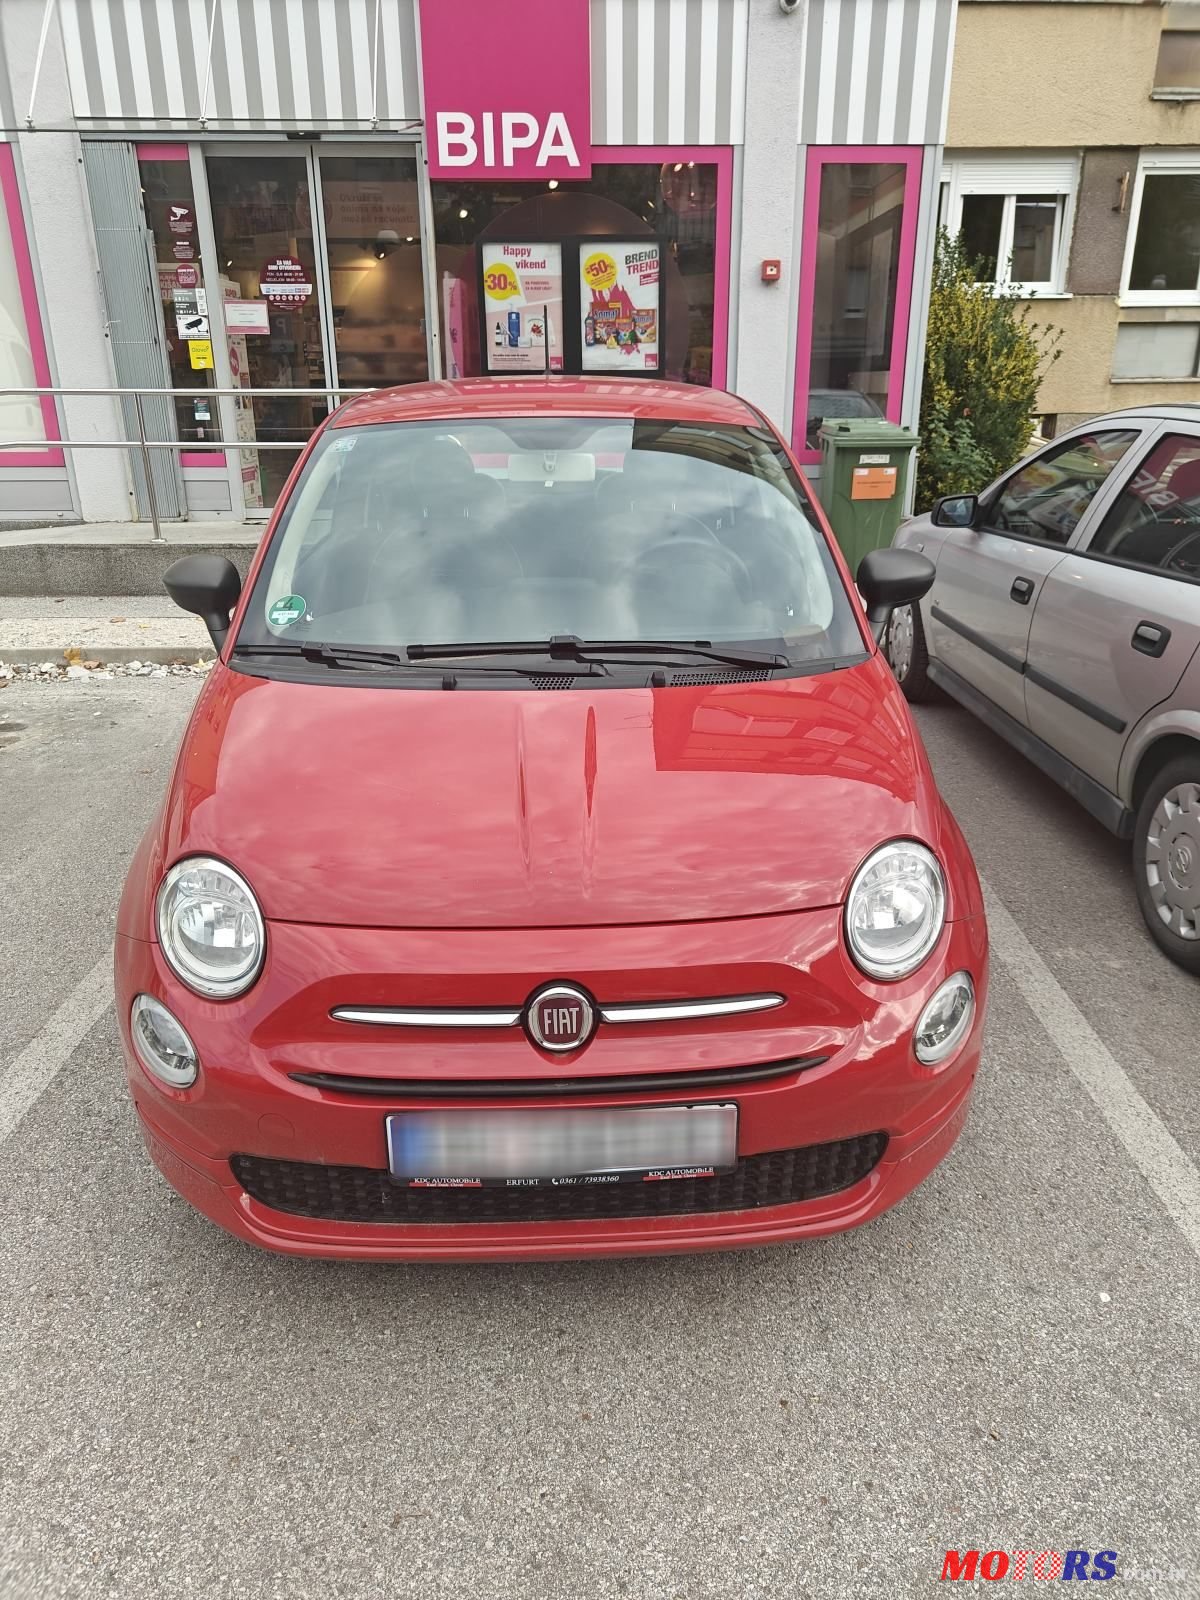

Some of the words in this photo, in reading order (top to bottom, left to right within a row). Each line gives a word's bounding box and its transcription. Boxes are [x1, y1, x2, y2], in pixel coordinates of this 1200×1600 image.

[436, 111, 581, 167] BIPA
[503, 245, 532, 257] Happy
[624, 249, 658, 265] BREND
[515, 259, 546, 269] vikend
[626, 259, 659, 275] TREND
[543, 1007, 580, 1035] FIAT
[506, 1178, 540, 1186] ERFURT
